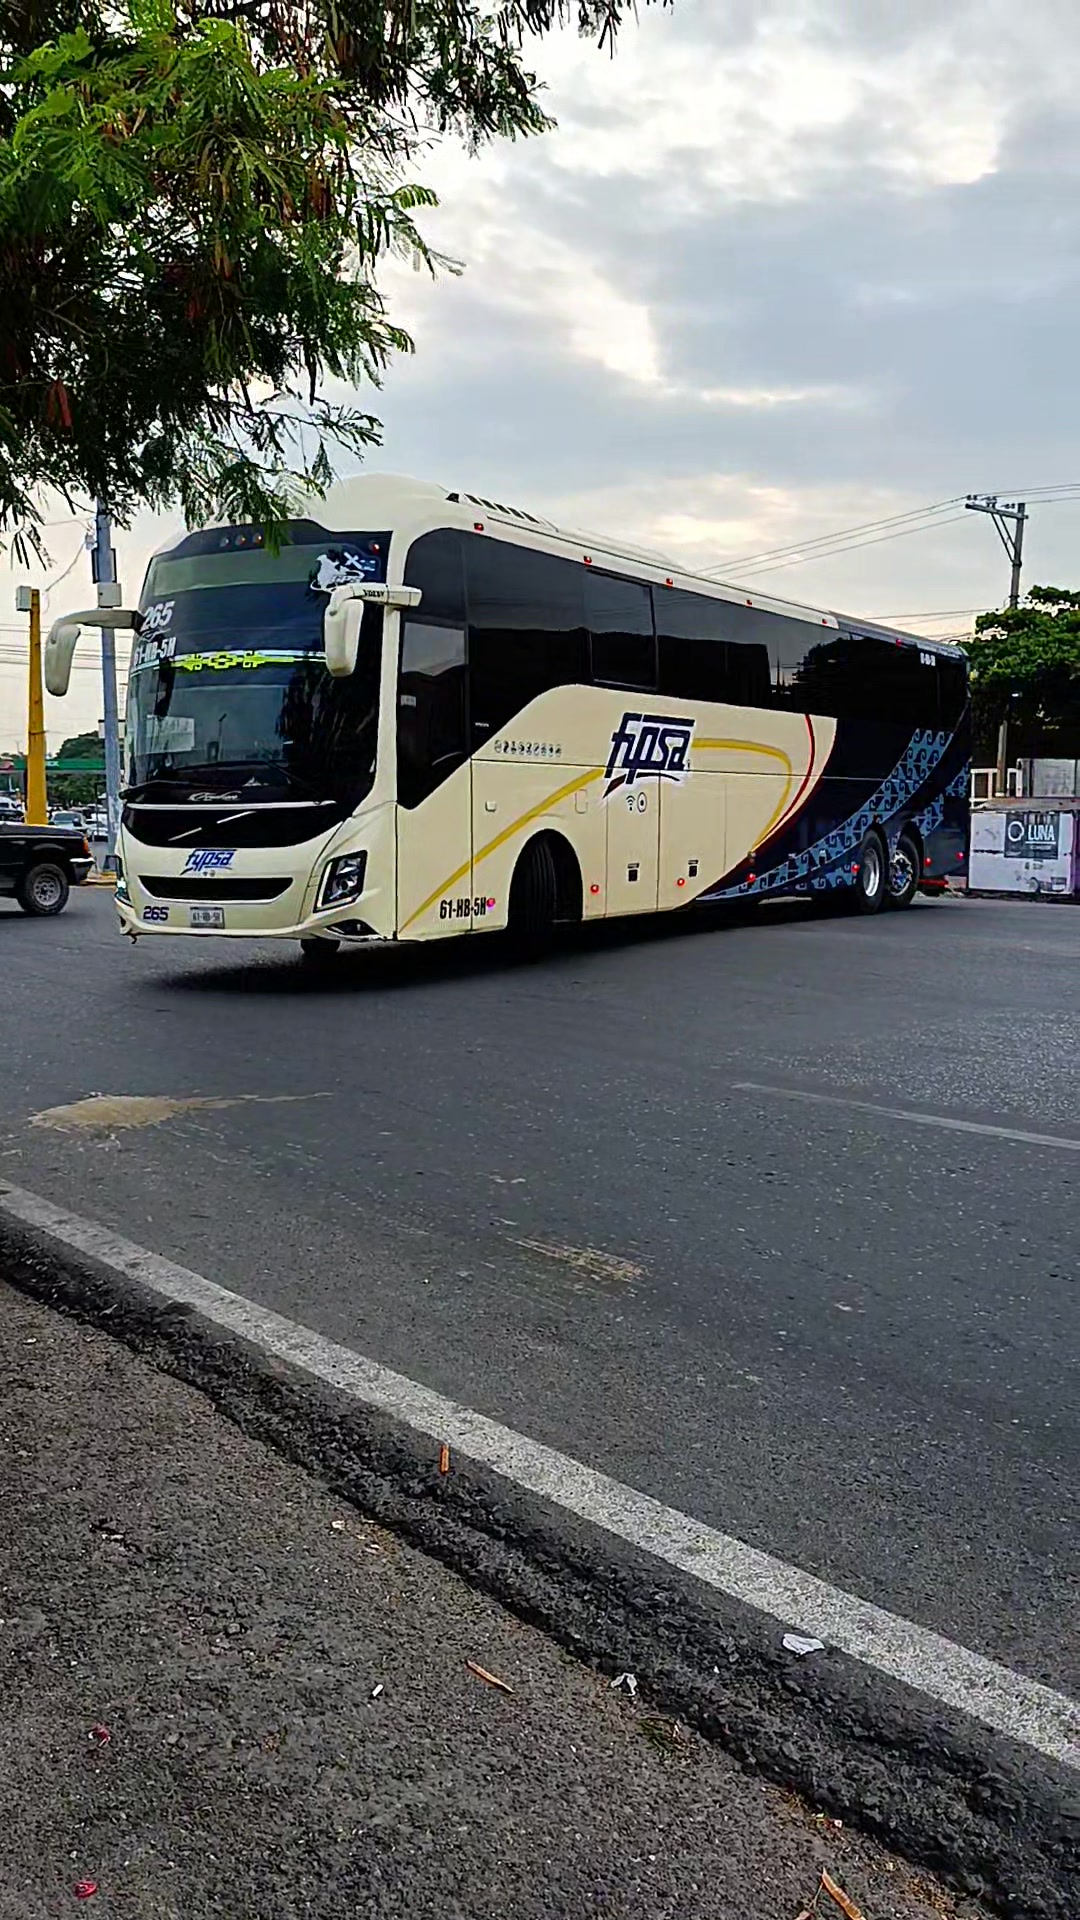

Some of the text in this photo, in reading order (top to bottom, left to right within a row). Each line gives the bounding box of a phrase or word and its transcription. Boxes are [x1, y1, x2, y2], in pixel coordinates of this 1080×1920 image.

[140, 601, 176, 632] 265
[1028, 824, 1055, 841] LUNA
[143, 905, 170, 921] 265
[439, 897, 487, 919] 61-HB-5H
